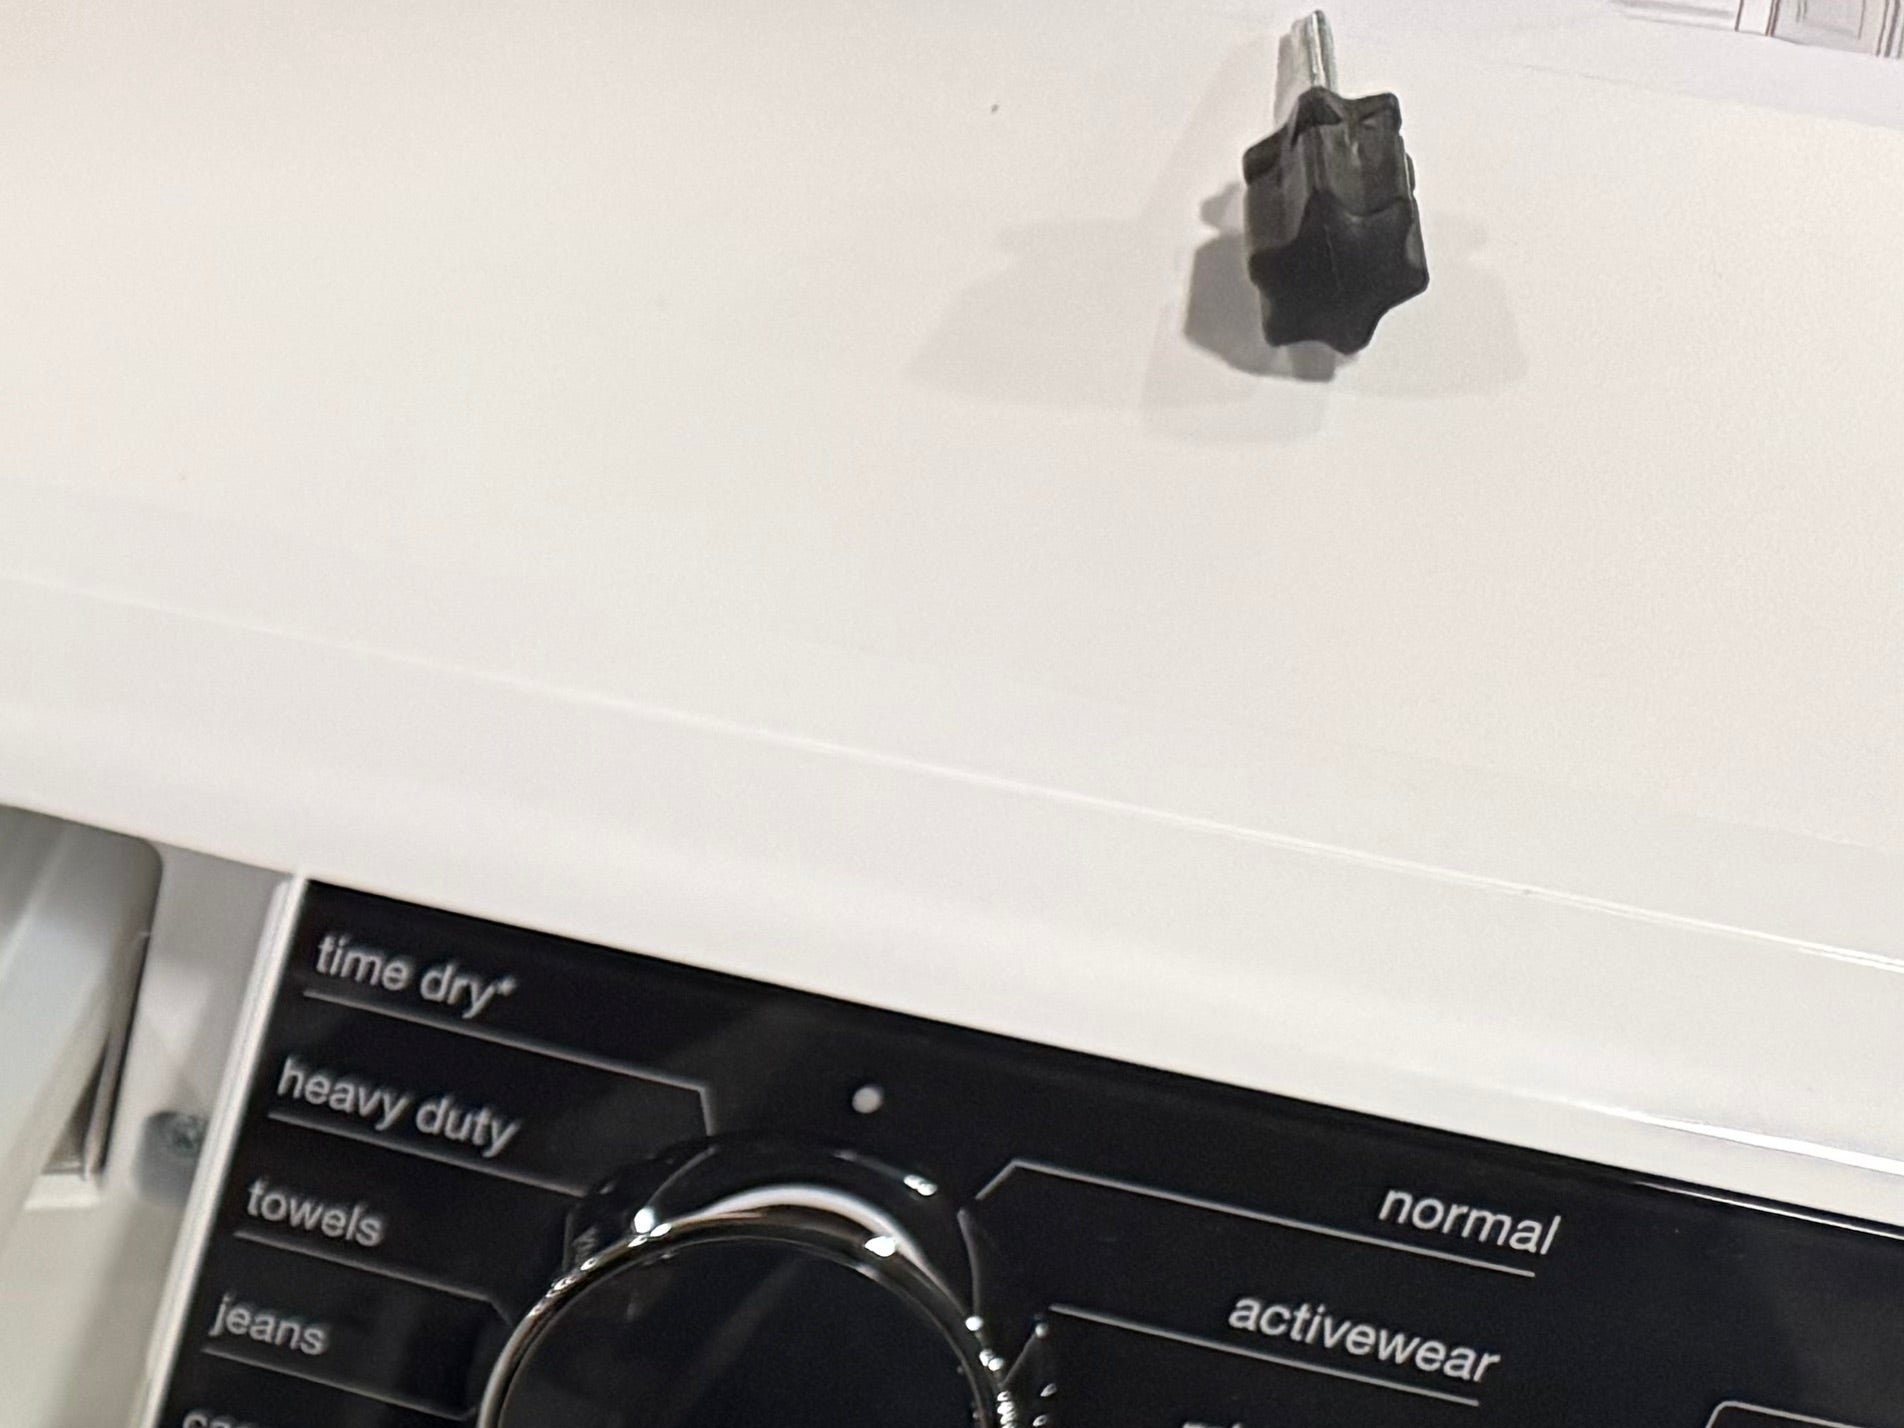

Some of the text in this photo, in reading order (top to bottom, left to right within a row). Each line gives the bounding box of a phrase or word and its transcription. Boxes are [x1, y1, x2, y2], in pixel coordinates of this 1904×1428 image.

[315, 933, 406, 991] time
[276, 1057, 520, 1158] heavy duty
[247, 1178, 384, 1247] towels
[1378, 1188, 1560, 1256] normal
[209, 1294, 327, 1356] jeans
[1228, 1291, 1500, 1384] activewear
